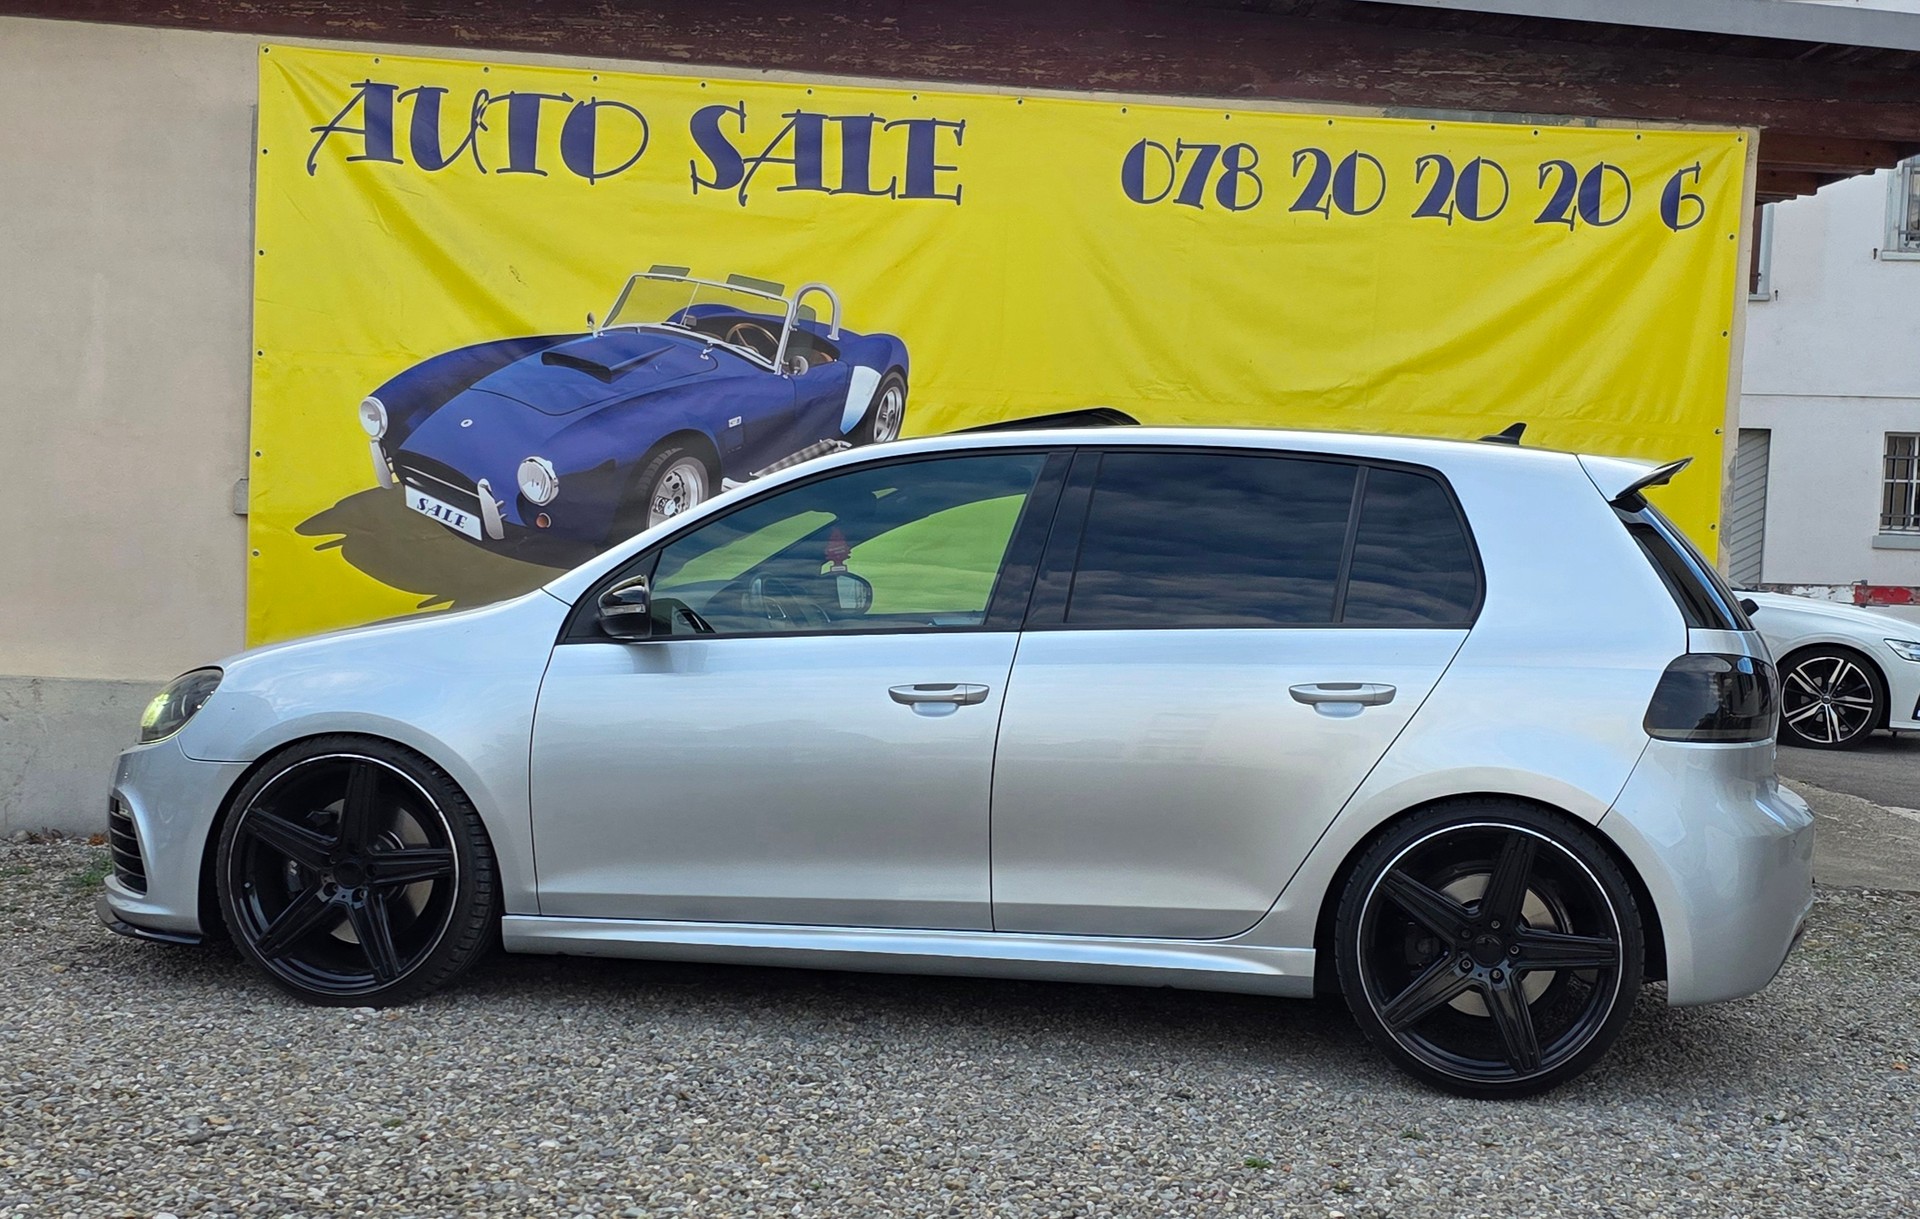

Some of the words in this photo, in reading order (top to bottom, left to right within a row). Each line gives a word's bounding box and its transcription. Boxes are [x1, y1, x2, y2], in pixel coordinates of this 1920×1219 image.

[306, 80, 649, 185] AUTO
[691, 100, 966, 206] SALE
[1121, 137, 1263, 211] 078
[1288, 147, 1387, 220] 20
[1412, 155, 1510, 227] 20
[1534, 160, 1632, 232] 20
[1659, 161, 1706, 233] 6
[417, 498, 467, 528] SALE
